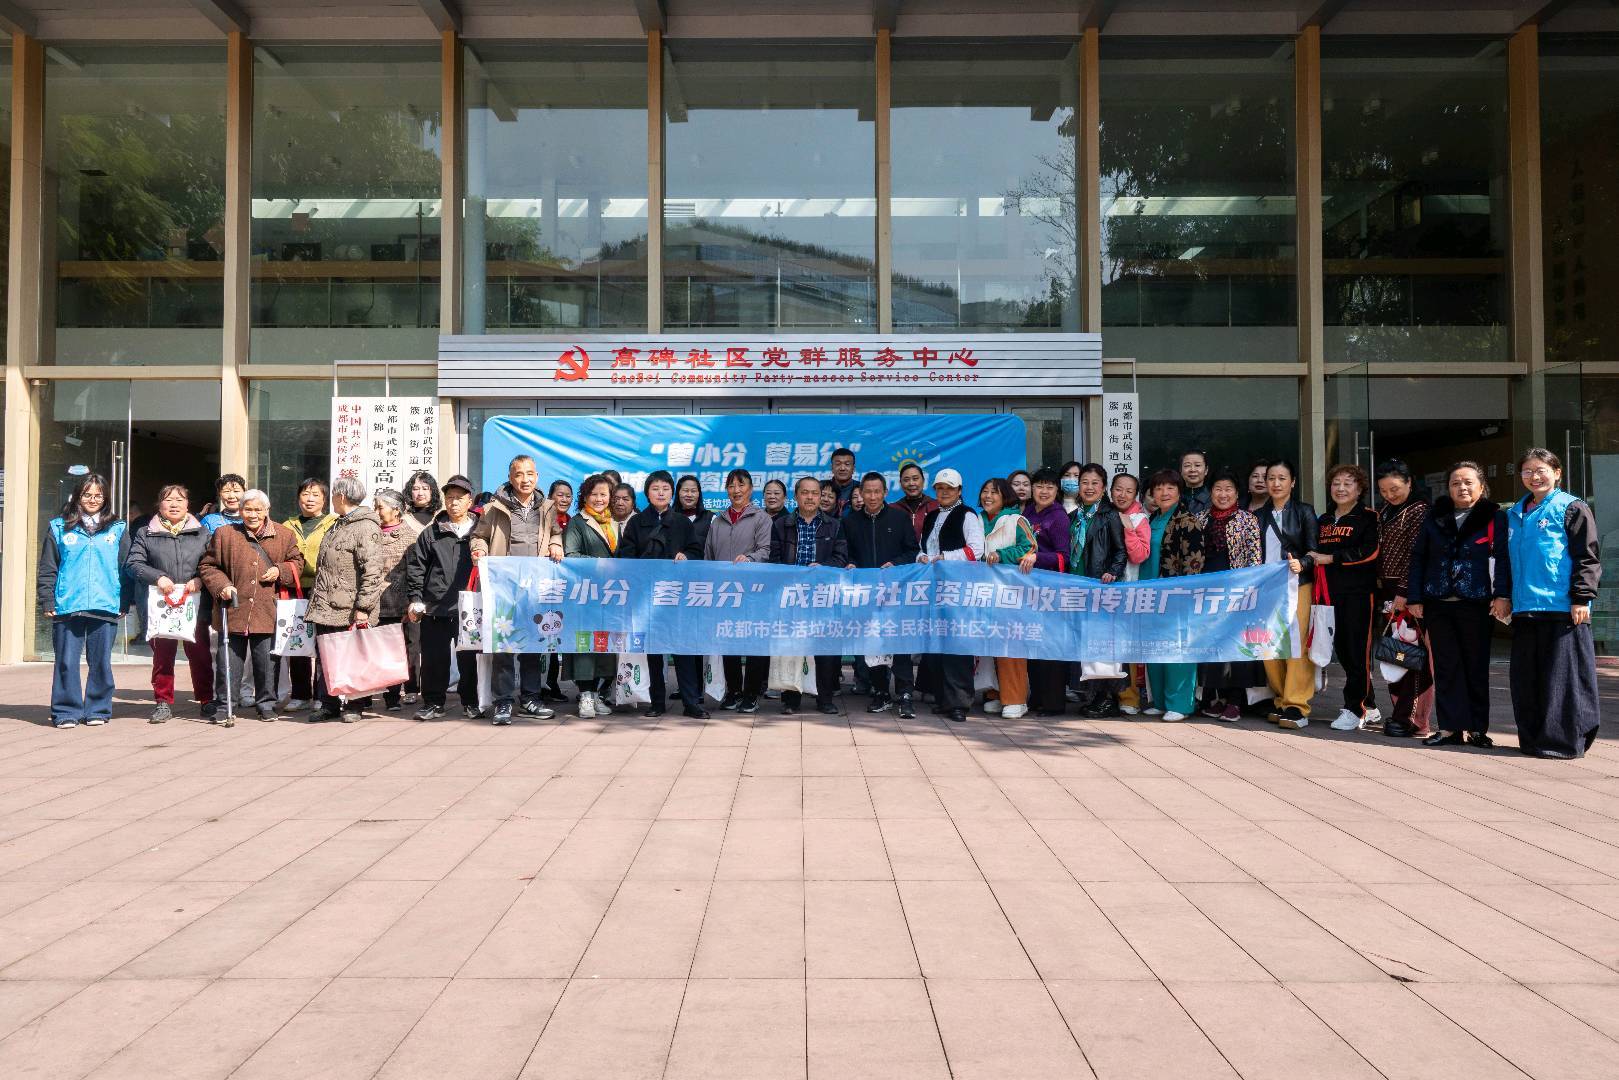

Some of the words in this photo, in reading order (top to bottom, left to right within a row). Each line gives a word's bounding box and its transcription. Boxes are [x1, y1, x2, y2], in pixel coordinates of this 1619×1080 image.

[611, 347, 979, 369] 高碑社区党群服务中心
[671, 372, 747, 384] Community
[860, 372, 919, 382] Service
[929, 372, 979, 382] Center
[350, 404, 361, 464] 中国共产党
[386, 404, 398, 468] 成都市武侯区
[423, 406, 434, 465] 成都市武侯区
[1122, 401, 1133, 461] 成都市武侯区
[780, 580, 1258, 614] 成都市社区资源回收宣传推广行动
[716, 620, 1044, 642] 成都市生活垃圾分类全民科普社区大讲堂
